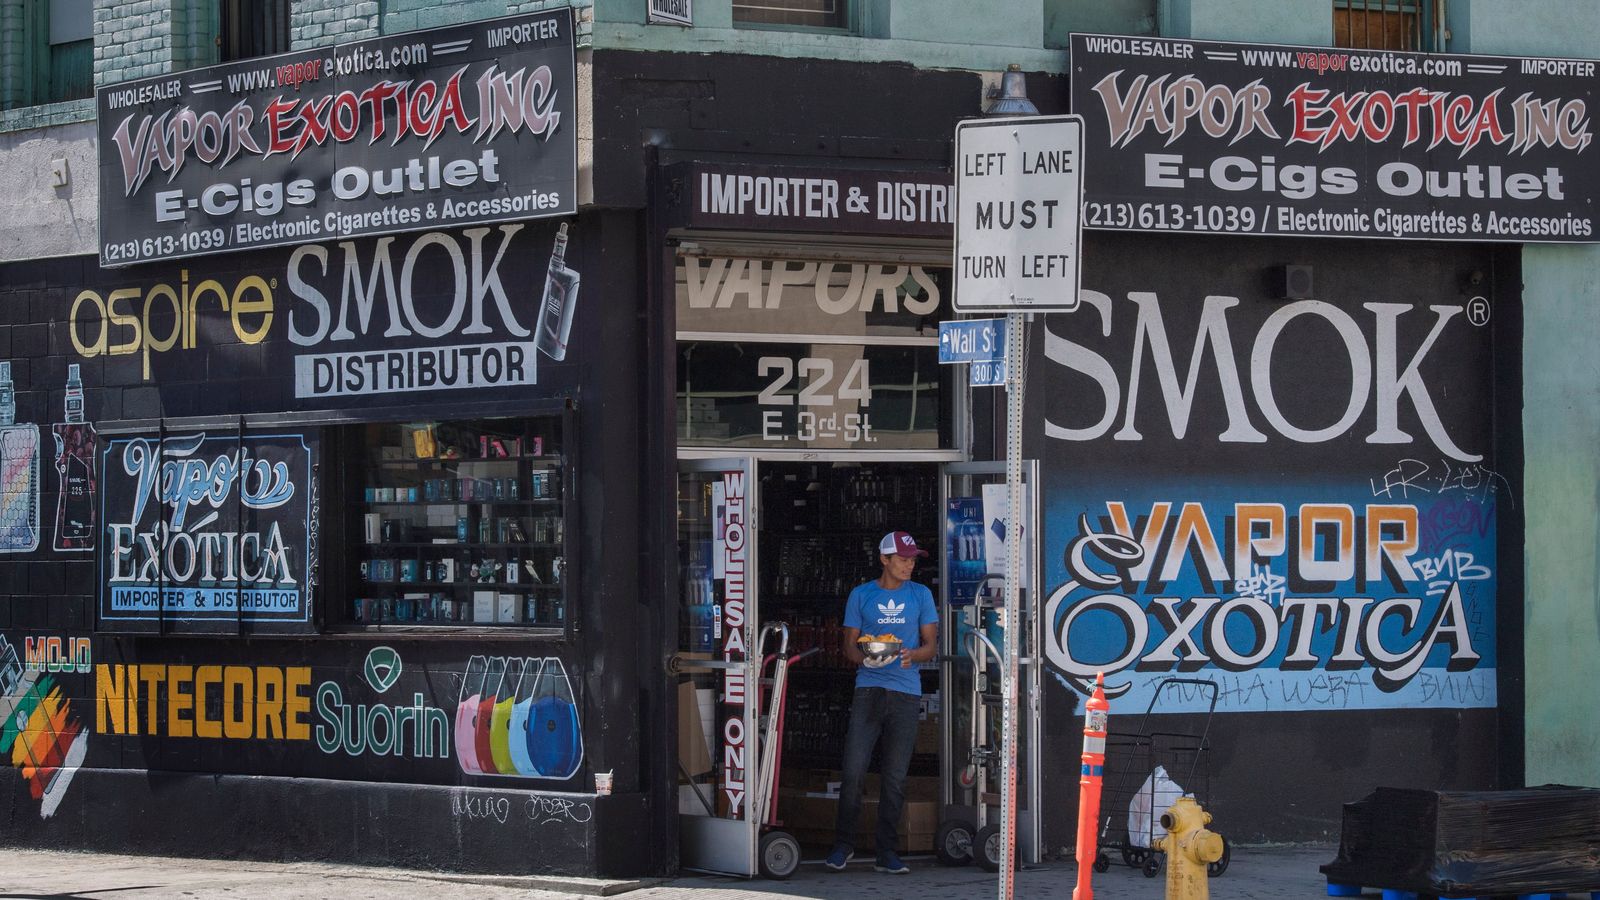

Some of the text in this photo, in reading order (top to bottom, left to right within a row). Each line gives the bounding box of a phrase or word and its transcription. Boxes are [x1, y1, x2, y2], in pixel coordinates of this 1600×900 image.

[107, 19, 559, 110] WHOLESALER www.vaporexotica.com IMPORTER
[1085, 37, 1595, 77] WHOLESALER www.vaporexotica.com IMPORTER
[111, 98, 263, 198] VAPOR
[261, 63, 478, 162] EXOTICA
[1091, 69, 1281, 150] VAPOR
[1283, 82, 1513, 160] EXOTICA
[155, 149, 500, 223] E-Cigs Outlet
[965, 151, 1073, 176] LEFT LANE
[1144, 153, 1565, 201] E-Cigs Outlet
[701, 172, 839, 219] IMPORTER
[846, 186, 870, 214] &
[976, 200, 1058, 230] MUST
[1081, 201, 1135, 229] (213)
[1138, 203, 1256, 232] 613-1039
[1277, 206, 1370, 233] Electronic
[1373, 208, 1467, 237] Cigarettes
[1471, 213, 1483, 233] &
[1486, 211, 1592, 236] Accessories
[104, 233, 141, 262] (213)
[142, 228, 225, 258] 613-1039
[236, 216, 321, 245] Electronic
[324, 206, 421, 239] Cigarettes
[425, 203, 438, 219] &
[441, 191, 560, 220] Accessories
[286, 223, 532, 347] SMOK
[684, 256, 940, 315] VAPORS
[962, 254, 1069, 279] TURN LEFT
[70, 269, 274, 380] aspire
[950, 326, 997, 354] Wall St
[313, 347, 525, 395] DISTRIBUTOR
[758, 356, 872, 407] 224
[975, 364, 1000, 382] 300 S
[1044, 289, 1484, 463] SMOK
[763, 411, 788, 441] E.
[844, 413, 878, 442] St.
[1105, 501, 1420, 583] VAPOR
[115, 591, 298, 609] IMPORTER & DISTRIBUTOR
[723, 472, 744, 703] WHOLESALE
[1044, 512, 1480, 694] EXOTICA
[877, 617, 906, 625] adidas
[25, 636, 92, 674] MOJO
[96, 664, 312, 740] NITECORE
[315, 680, 449, 759] Suorin
[723, 718, 744, 815] ONLY
